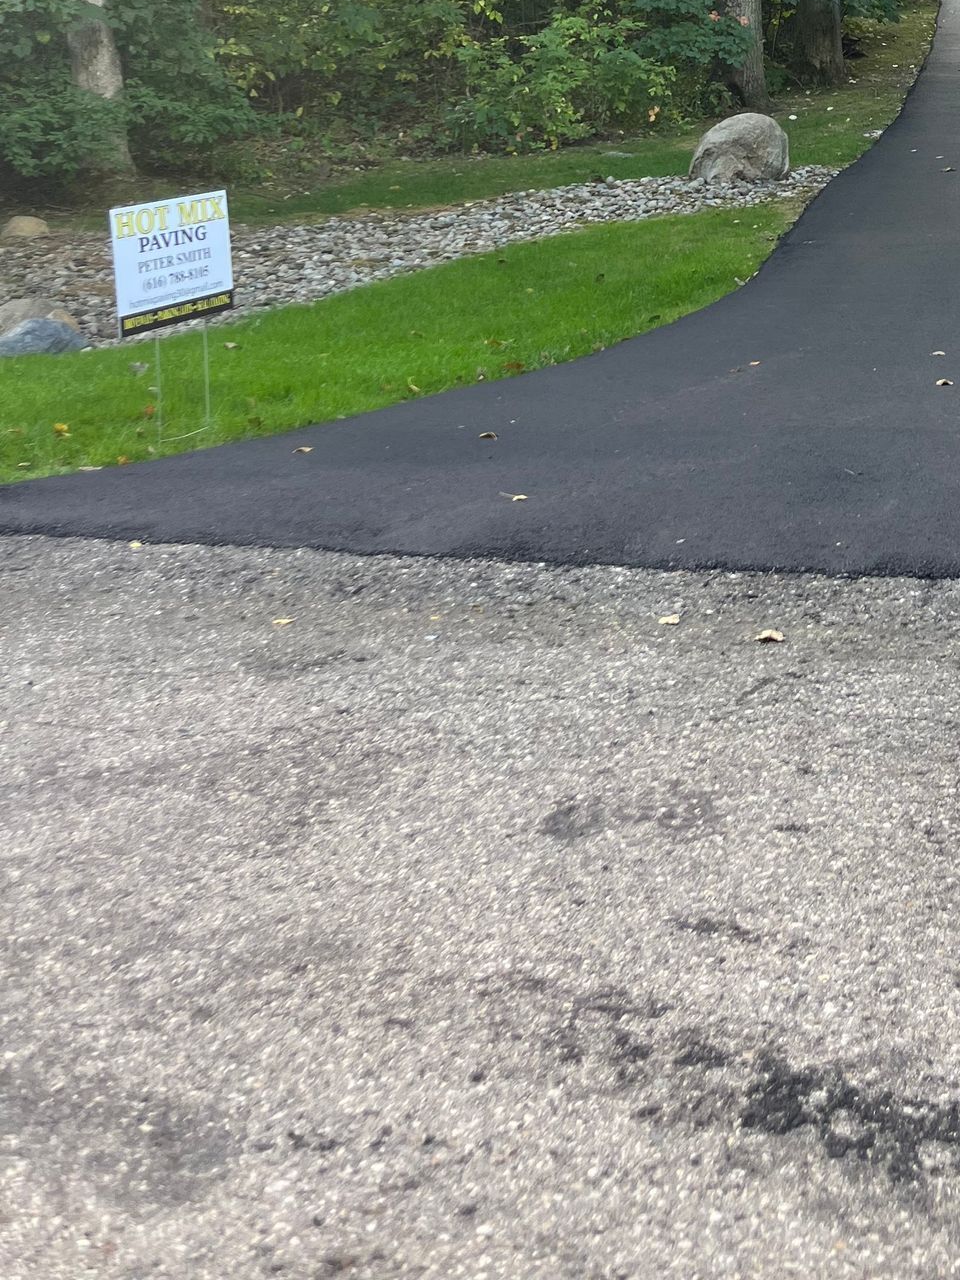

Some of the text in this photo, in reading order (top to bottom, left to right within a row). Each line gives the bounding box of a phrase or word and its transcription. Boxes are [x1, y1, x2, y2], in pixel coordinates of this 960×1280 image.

[114, 195, 225, 239] HOT MIX
[138, 225, 208, 253] PAVING
[138, 247, 212, 274] PETER SMITH
[142, 275, 167, 293] (616)
